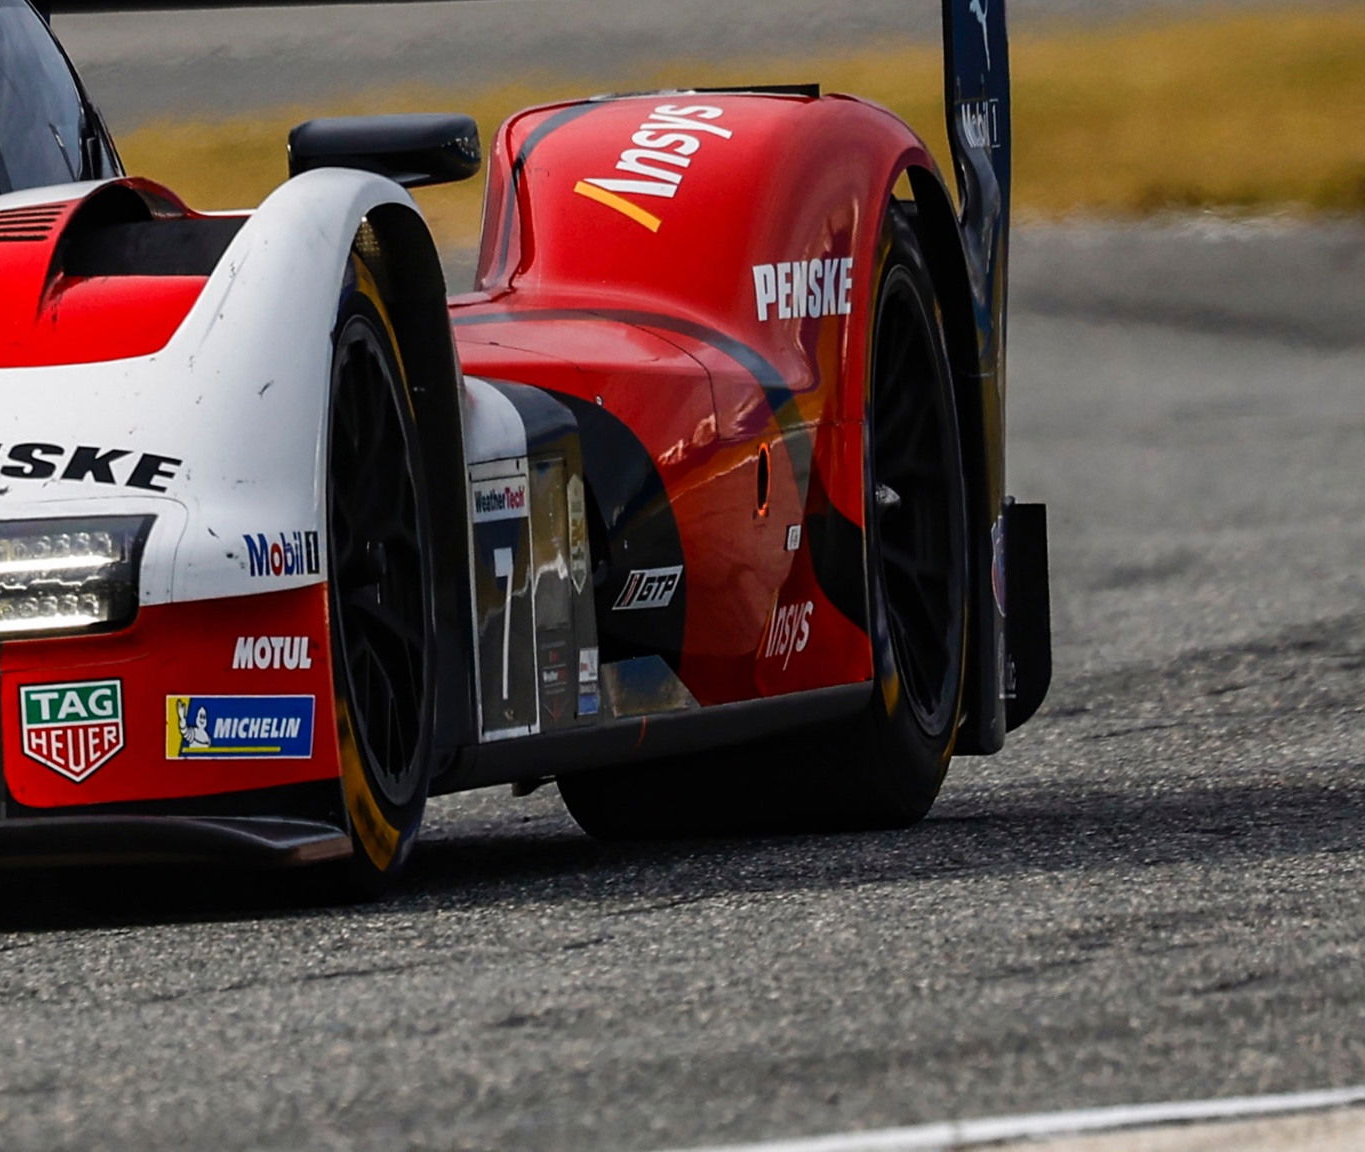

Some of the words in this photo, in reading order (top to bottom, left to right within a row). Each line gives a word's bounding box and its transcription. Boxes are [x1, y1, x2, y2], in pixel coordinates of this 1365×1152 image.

[573, 104, 733, 233] Ansys
[753, 257, 854, 322] PENSKE
[474, 486, 526, 513] WeatherTech
[242, 531, 305, 578] Mobil
[305, 530, 321, 576] 1
[636, 573, 678, 602] GTP
[493, 547, 515, 700] 7
[231, 635, 313, 671] MOTUL
[29, 686, 115, 721] TAG
[213, 715, 302, 741] MICHELIN
[30, 724, 119, 779] HEUER
